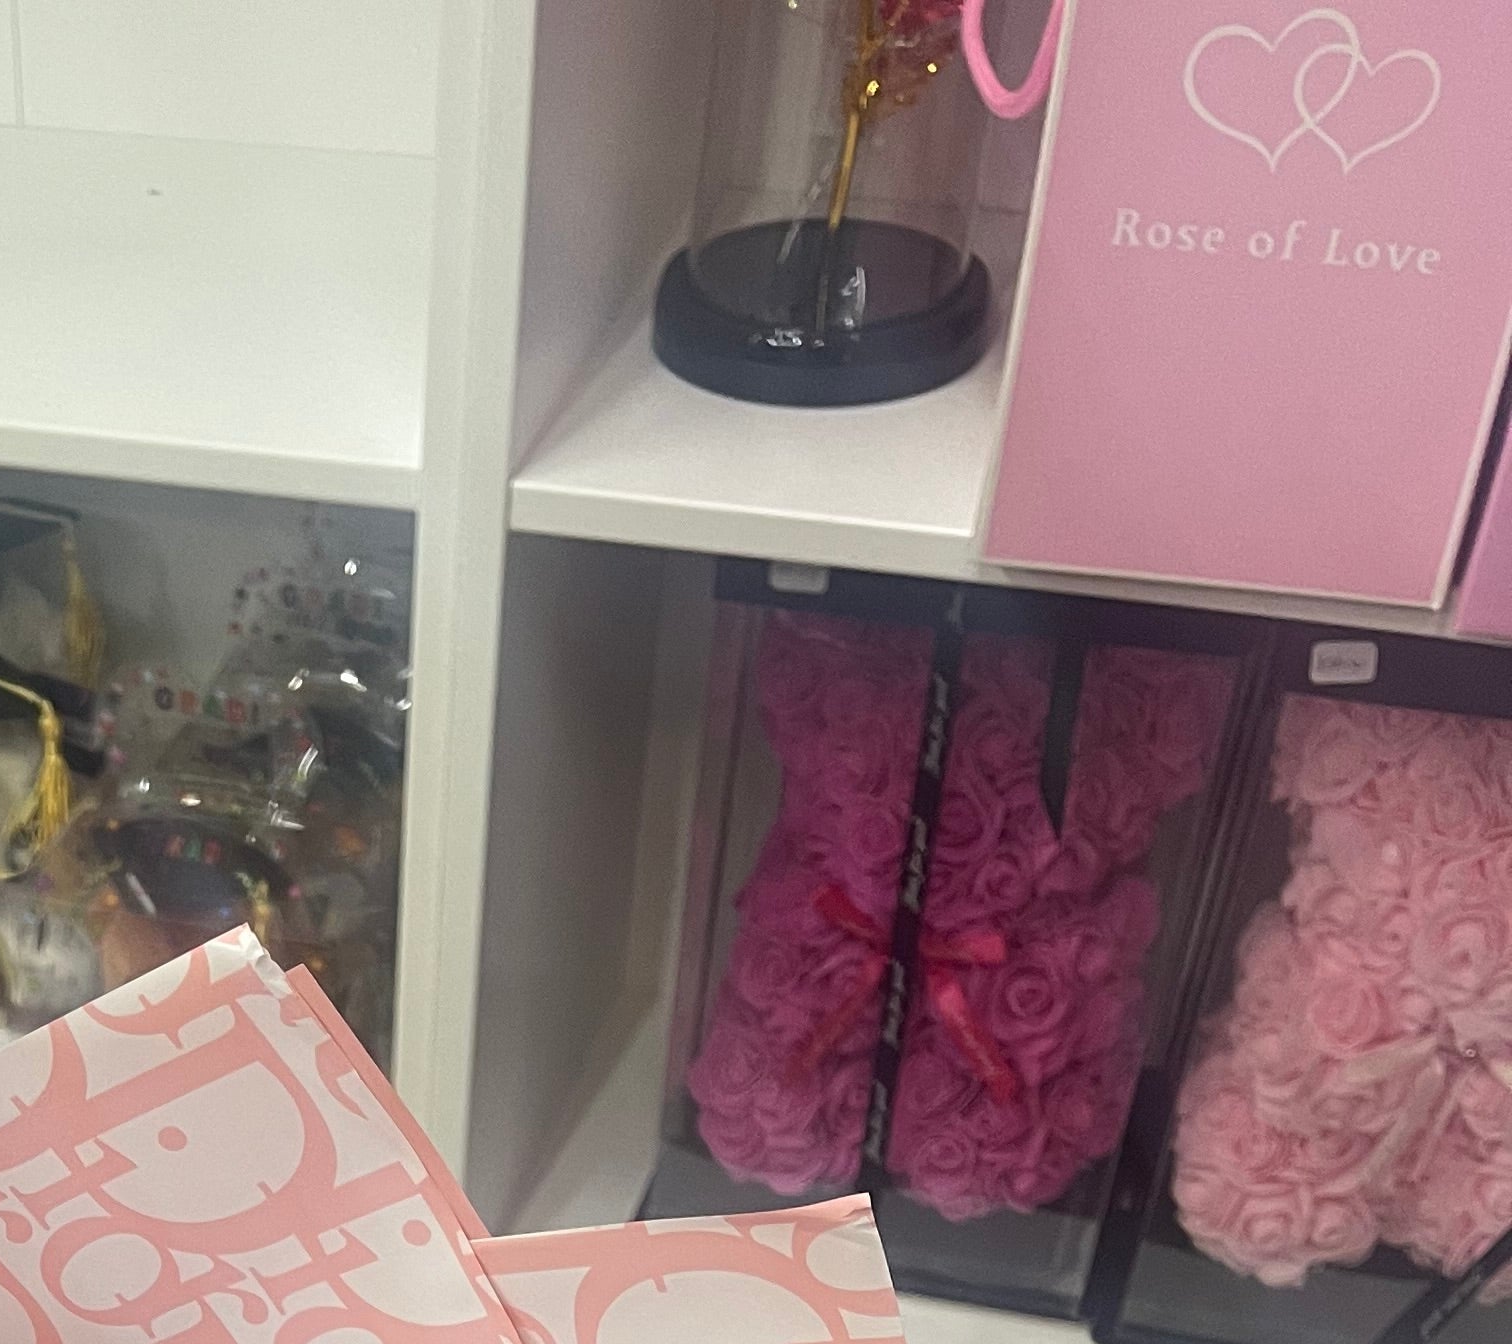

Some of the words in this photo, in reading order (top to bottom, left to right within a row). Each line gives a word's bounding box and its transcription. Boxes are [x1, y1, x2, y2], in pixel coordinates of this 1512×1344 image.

[1111, 207, 1226, 254] Rose
[1248, 219, 1308, 260] of
[1323, 229, 1442, 275] Love
